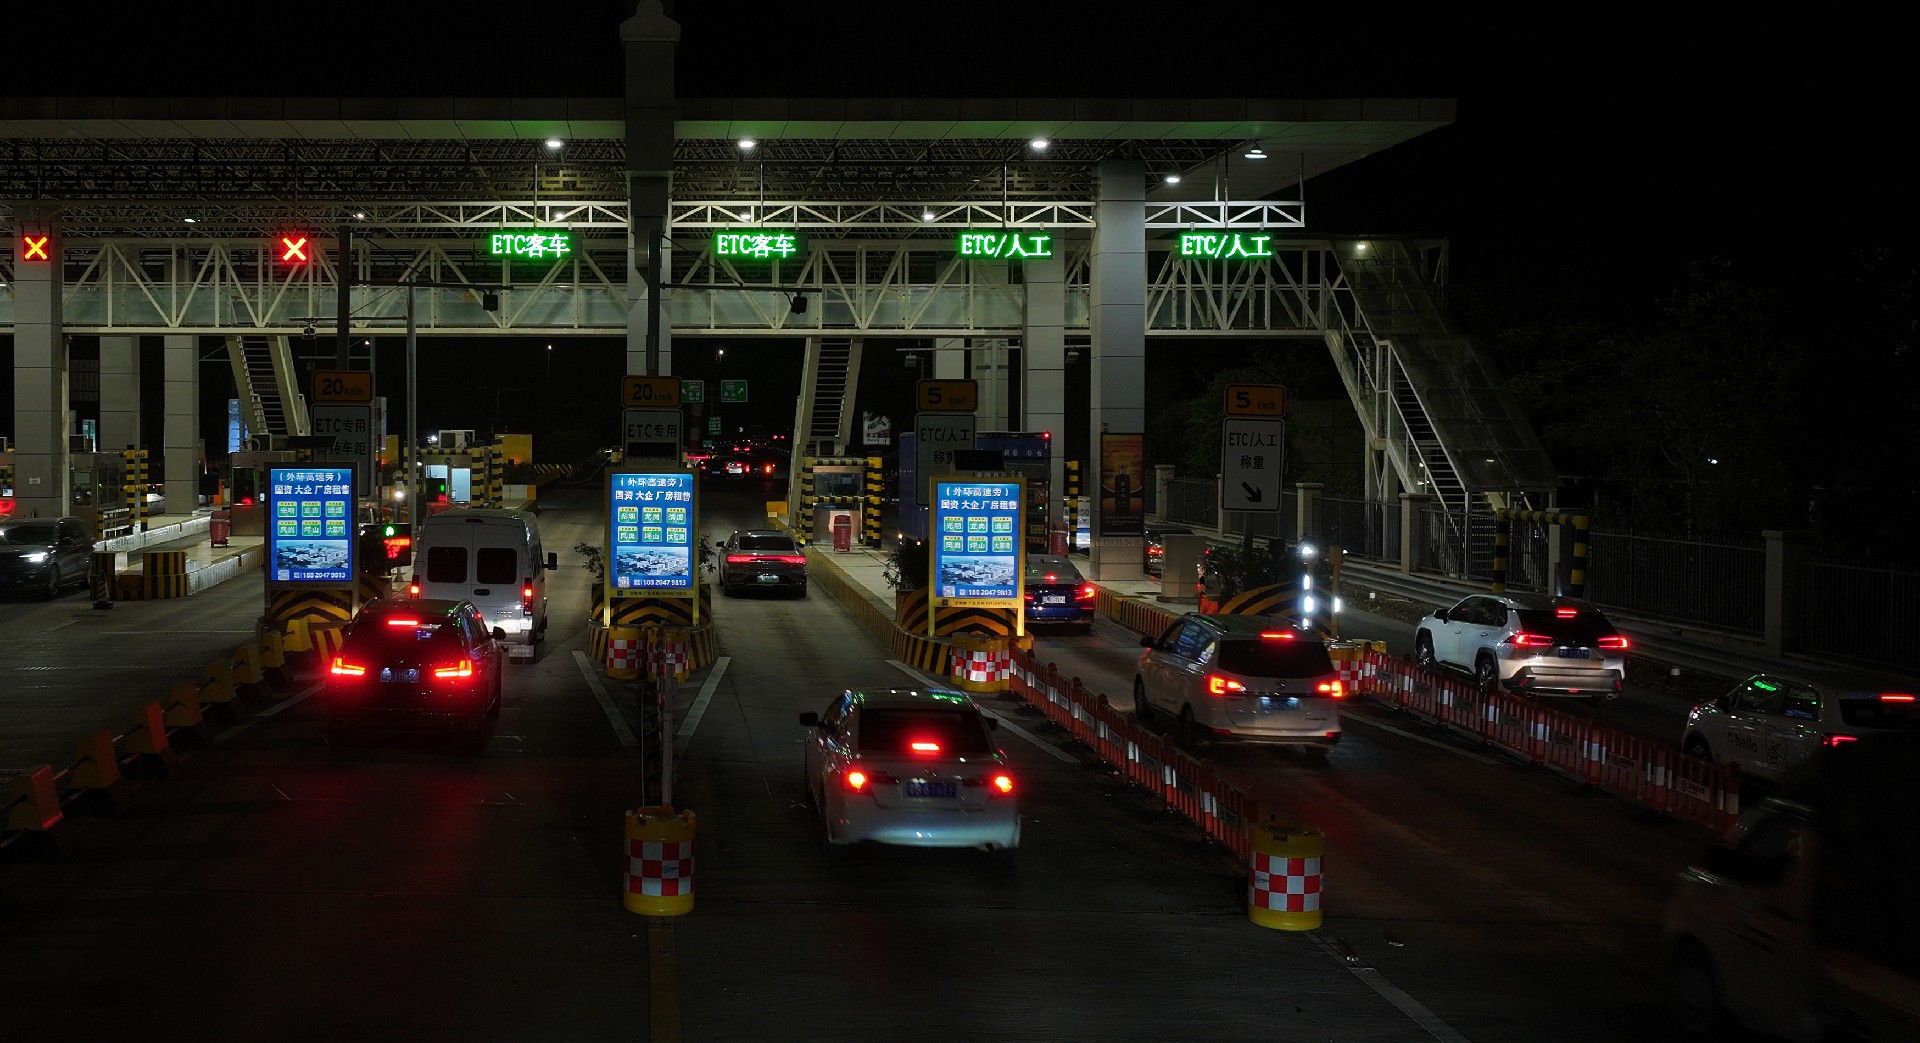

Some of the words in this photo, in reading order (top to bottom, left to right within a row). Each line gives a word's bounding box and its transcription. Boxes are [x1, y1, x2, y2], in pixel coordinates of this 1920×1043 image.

[492, 234, 570, 258] ETC客车
[717, 234, 796, 258] ETC客车
[961, 234, 1051, 258] ETC/人工
[1181, 234, 1272, 258] ETC/人工
[322, 378, 343, 395] 20
[632, 383, 653, 400] 20
[928, 387, 942, 404] 5
[1237, 392, 1250, 408] 5
[1257, 401, 1276, 410] km/h
[316, 418, 366, 433] ETC专用
[627, 424, 677, 438] ETC专用
[920, 427, 970, 441] ETC/人工
[1229, 432, 1277, 447] ETC/人工
[1241, 454, 1264, 470] 称重
[274, 485, 293, 495] 国资
[295, 485, 313, 495] 大企
[615, 490, 633, 500] 国资
[635, 490, 654, 500] 大企
[941, 499, 959, 509] 国资
[961, 500, 979, 509] 大企
[1735, 733, 1758, 753] hello
